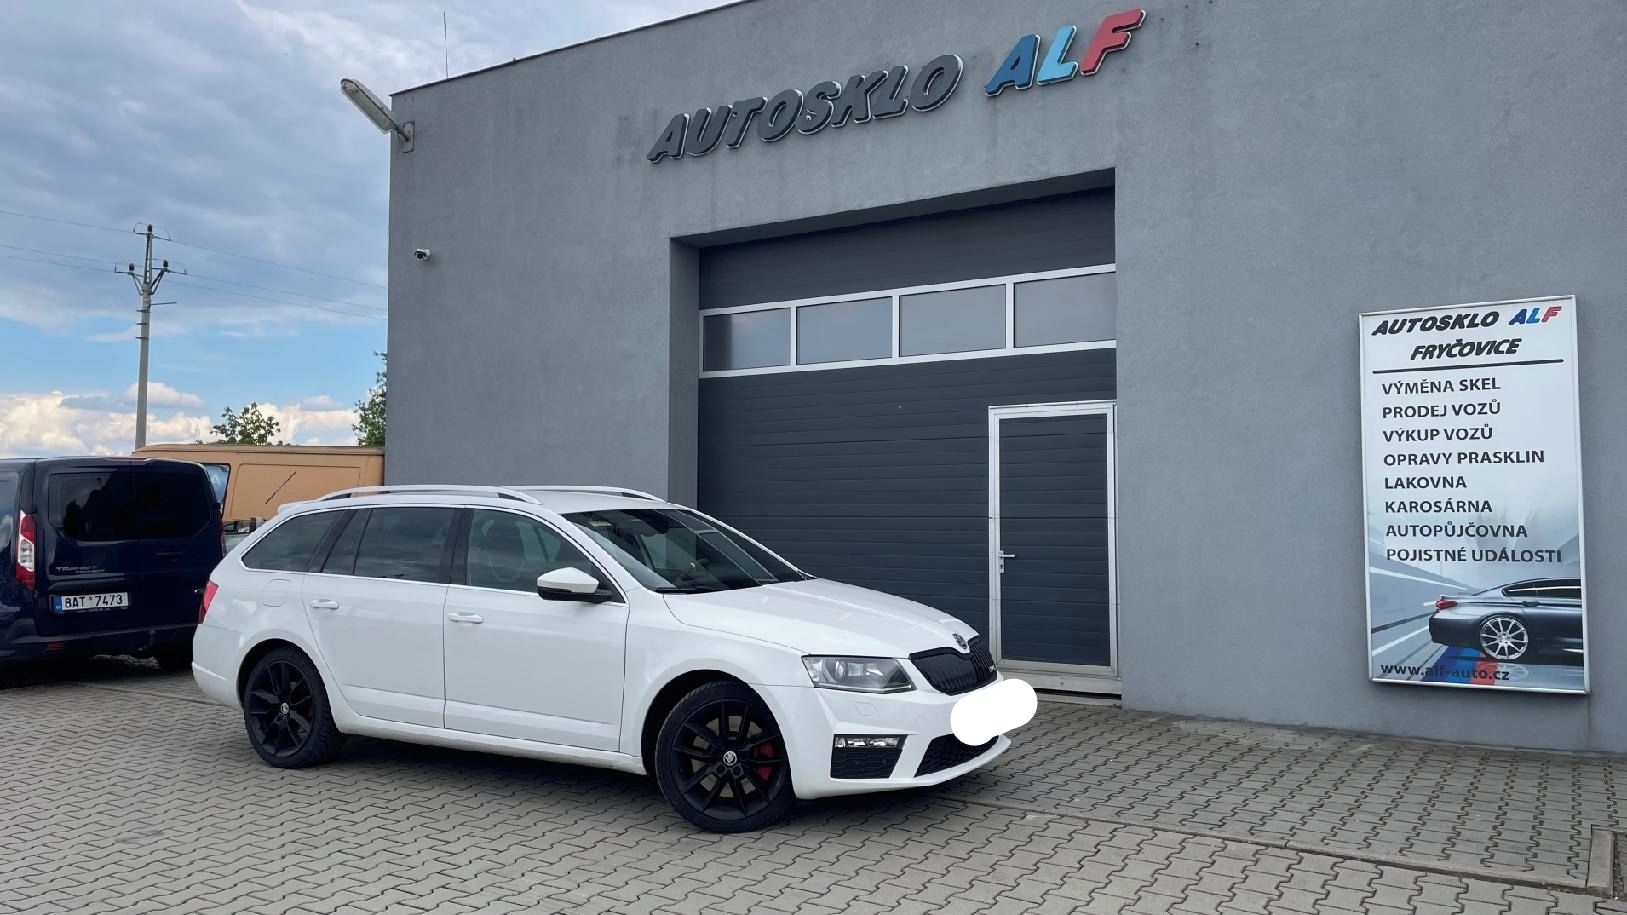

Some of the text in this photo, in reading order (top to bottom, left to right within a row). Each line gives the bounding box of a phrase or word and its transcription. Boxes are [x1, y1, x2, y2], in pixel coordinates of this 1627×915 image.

[647, 8, 1146, 163] AUTOSKLO ALF
[1371, 306, 1562, 336] AUTOSKLO ALF
[1410, 338, 1522, 361] FRYČOVICE
[1382, 377, 1501, 395] VÝMĚNA SKEL
[1382, 399, 1501, 419] PRODEJ VOZŮ
[1383, 424, 1493, 442] VÝKUP VOZŮ
[1383, 450, 1545, 466] OPRAVY PRASKLIN
[1384, 476, 1467, 489] LAKOVNA
[1385, 498, 1493, 513] KAROSÁRNA
[1386, 521, 1528, 538] AUTOPŮJČOVNA
[1386, 546, 1562, 563] POJISTNÉ UDÁLOSTI
[65, 594, 123, 608] 8AT 7473
[1381, 664, 1510, 681] www.alf-auto.cz
